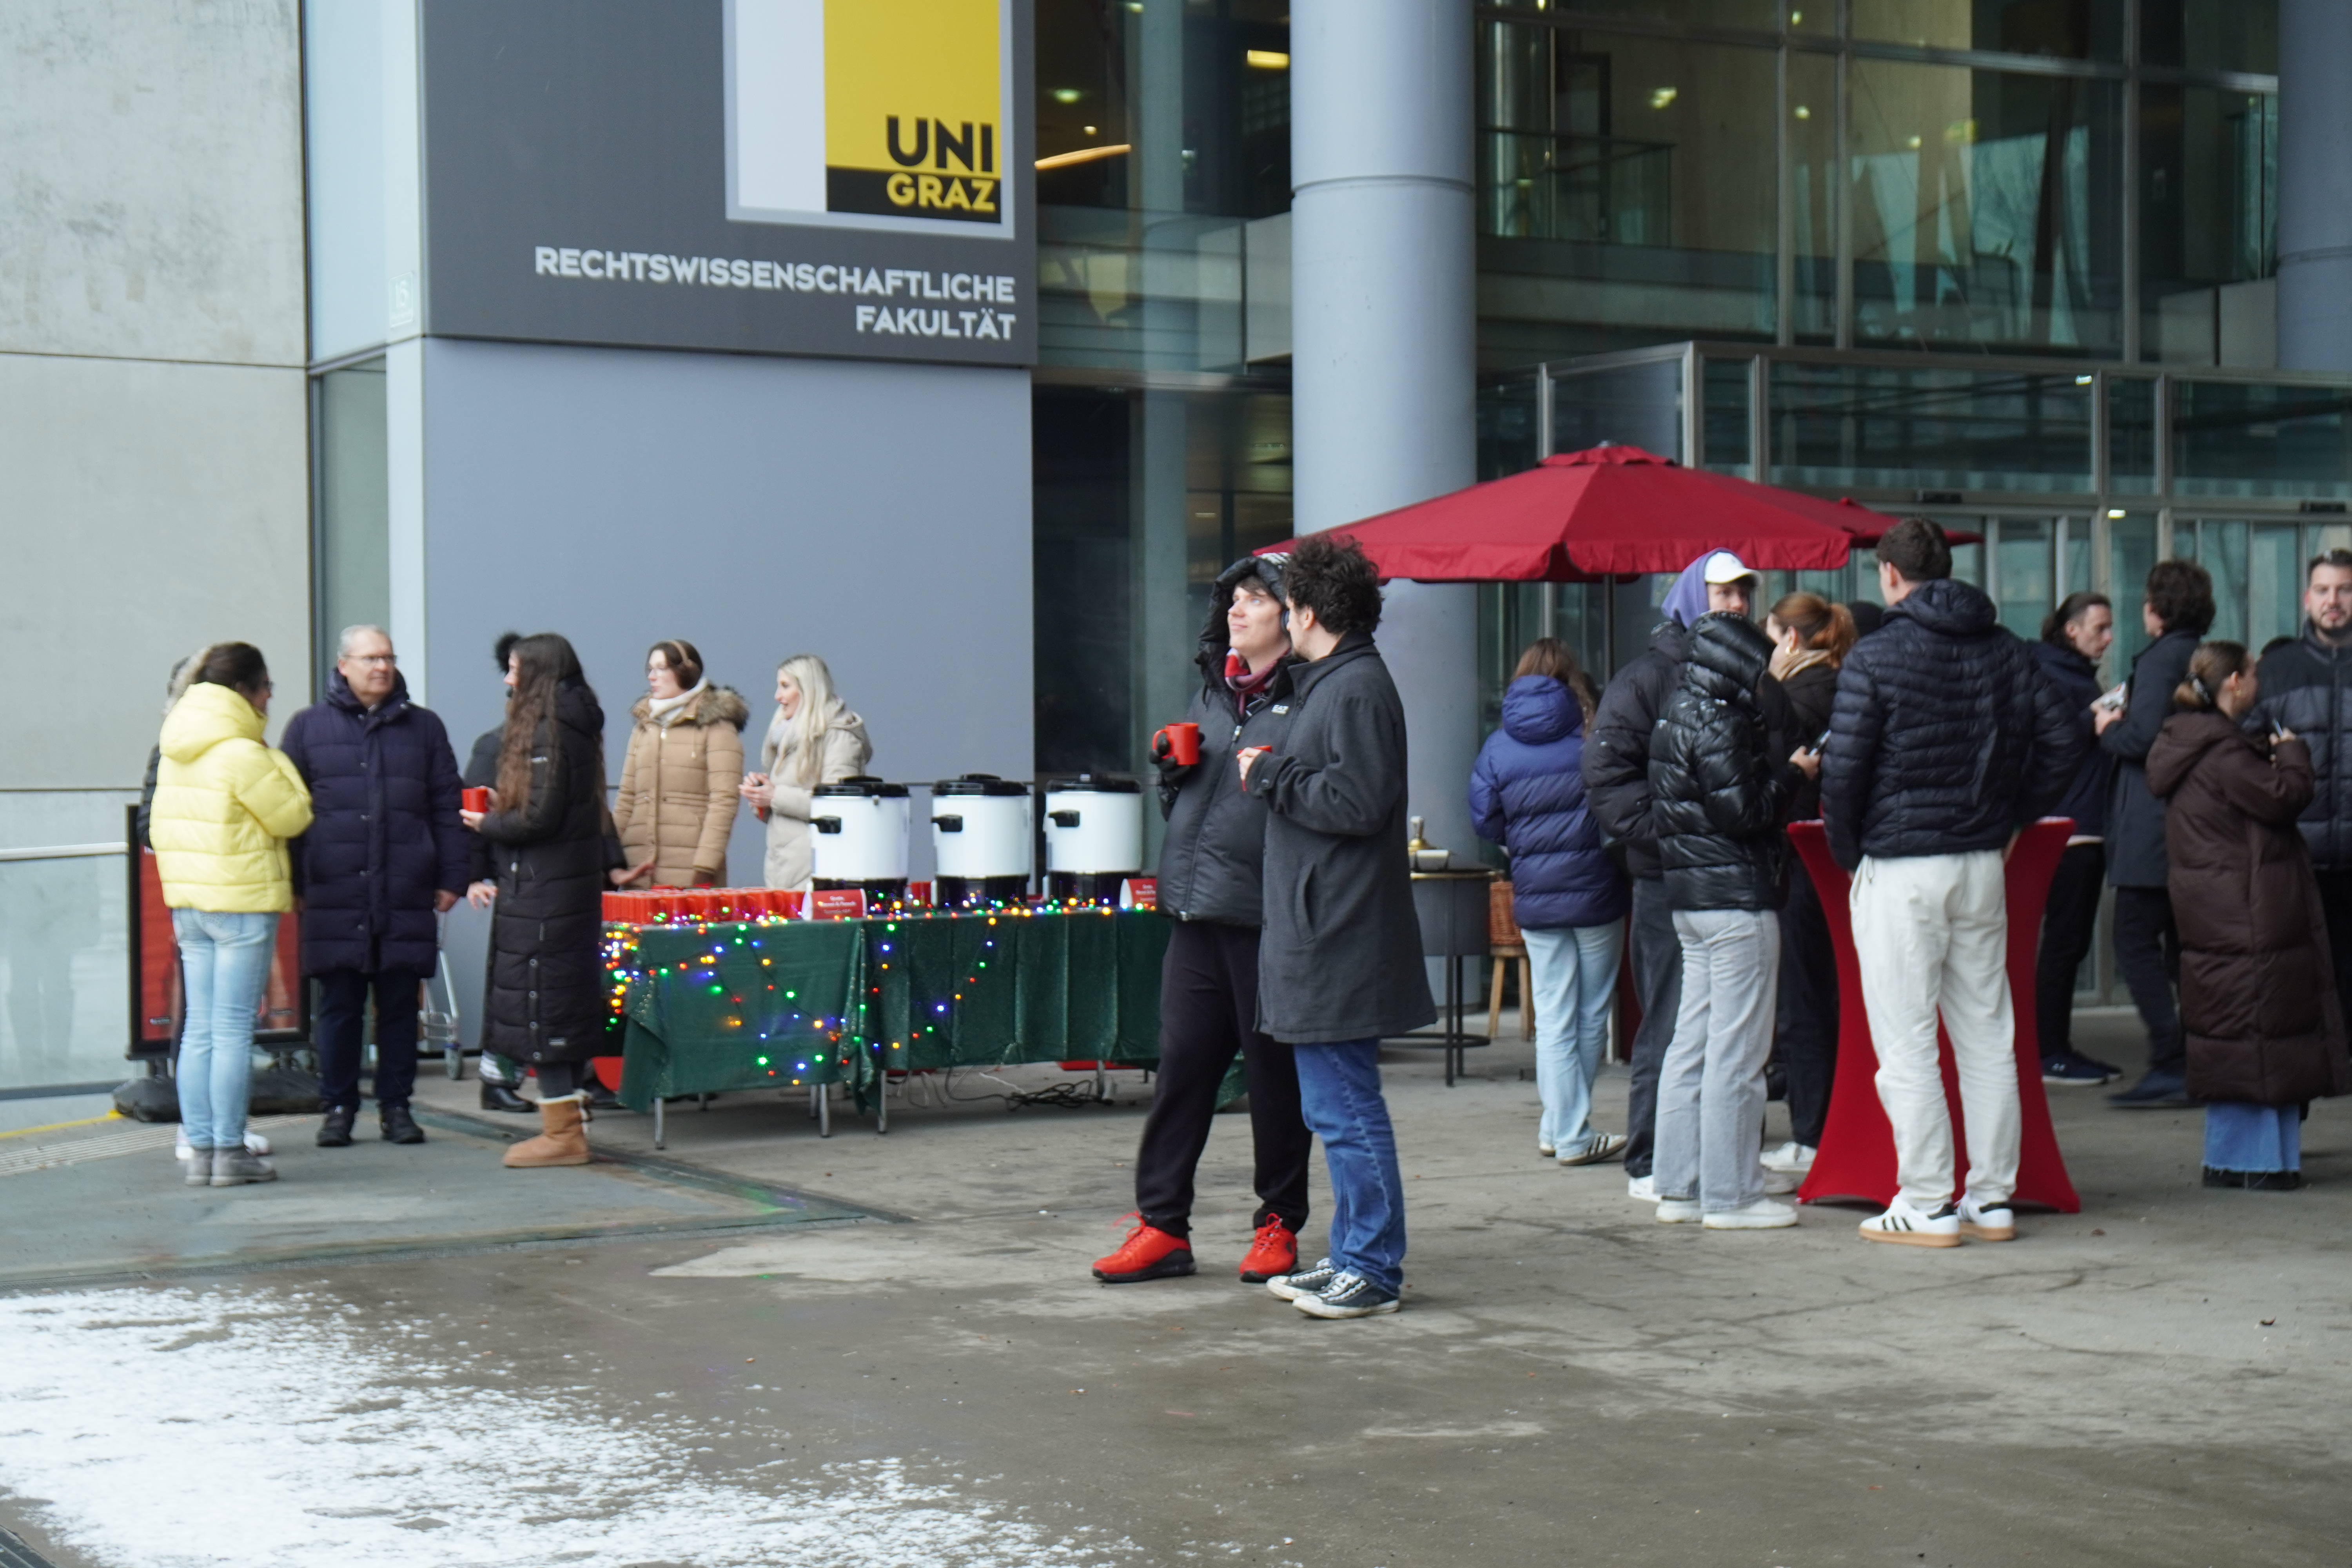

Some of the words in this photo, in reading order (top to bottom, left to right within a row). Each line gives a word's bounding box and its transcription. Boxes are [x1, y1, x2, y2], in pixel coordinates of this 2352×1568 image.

[887, 116, 993, 171] UNI
[887, 174, 996, 212] GRAZ
[535, 247, 1014, 303] RECHTSWISSENSCHAFTLICHE
[857, 306, 1015, 339] FAKULTÄT
